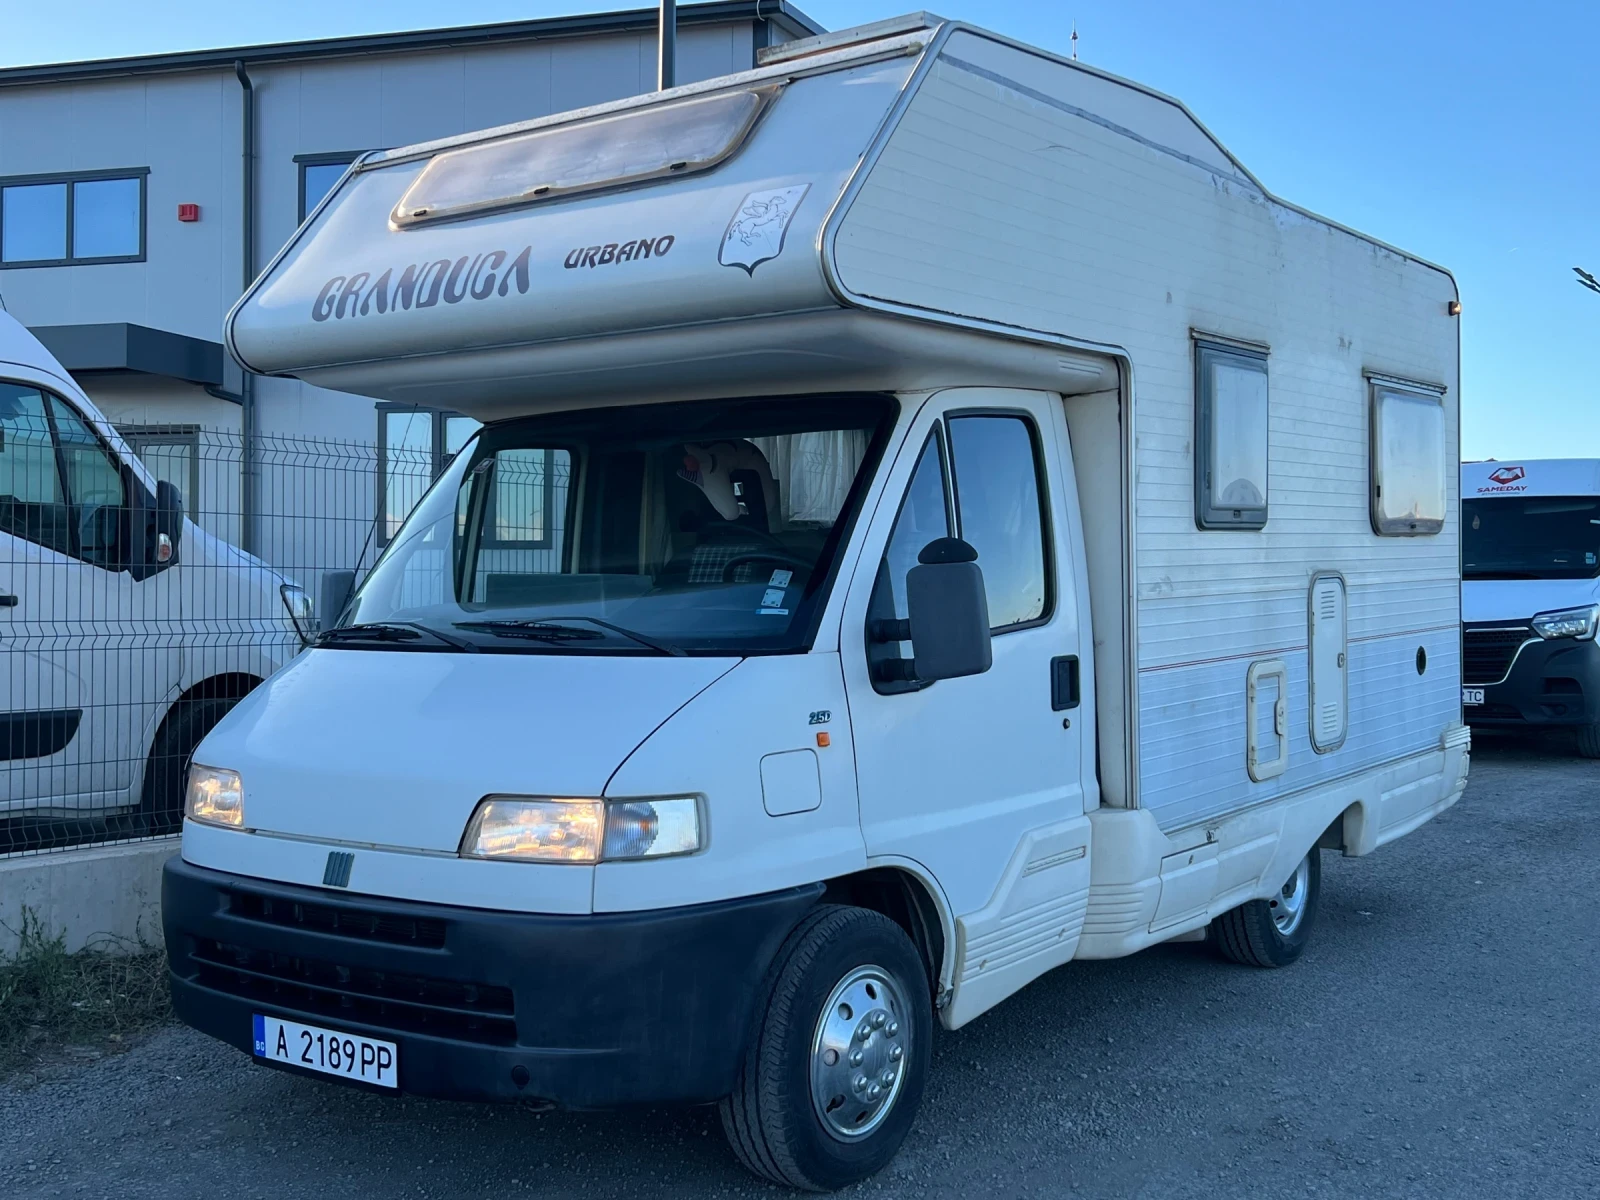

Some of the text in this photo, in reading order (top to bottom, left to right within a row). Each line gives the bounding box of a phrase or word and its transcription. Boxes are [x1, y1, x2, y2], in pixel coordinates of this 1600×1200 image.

[311, 234, 675, 322] GRANDUCA URBANO
[1476, 485, 1528, 493] SAMEDAY
[276, 1024, 289, 1058] A
